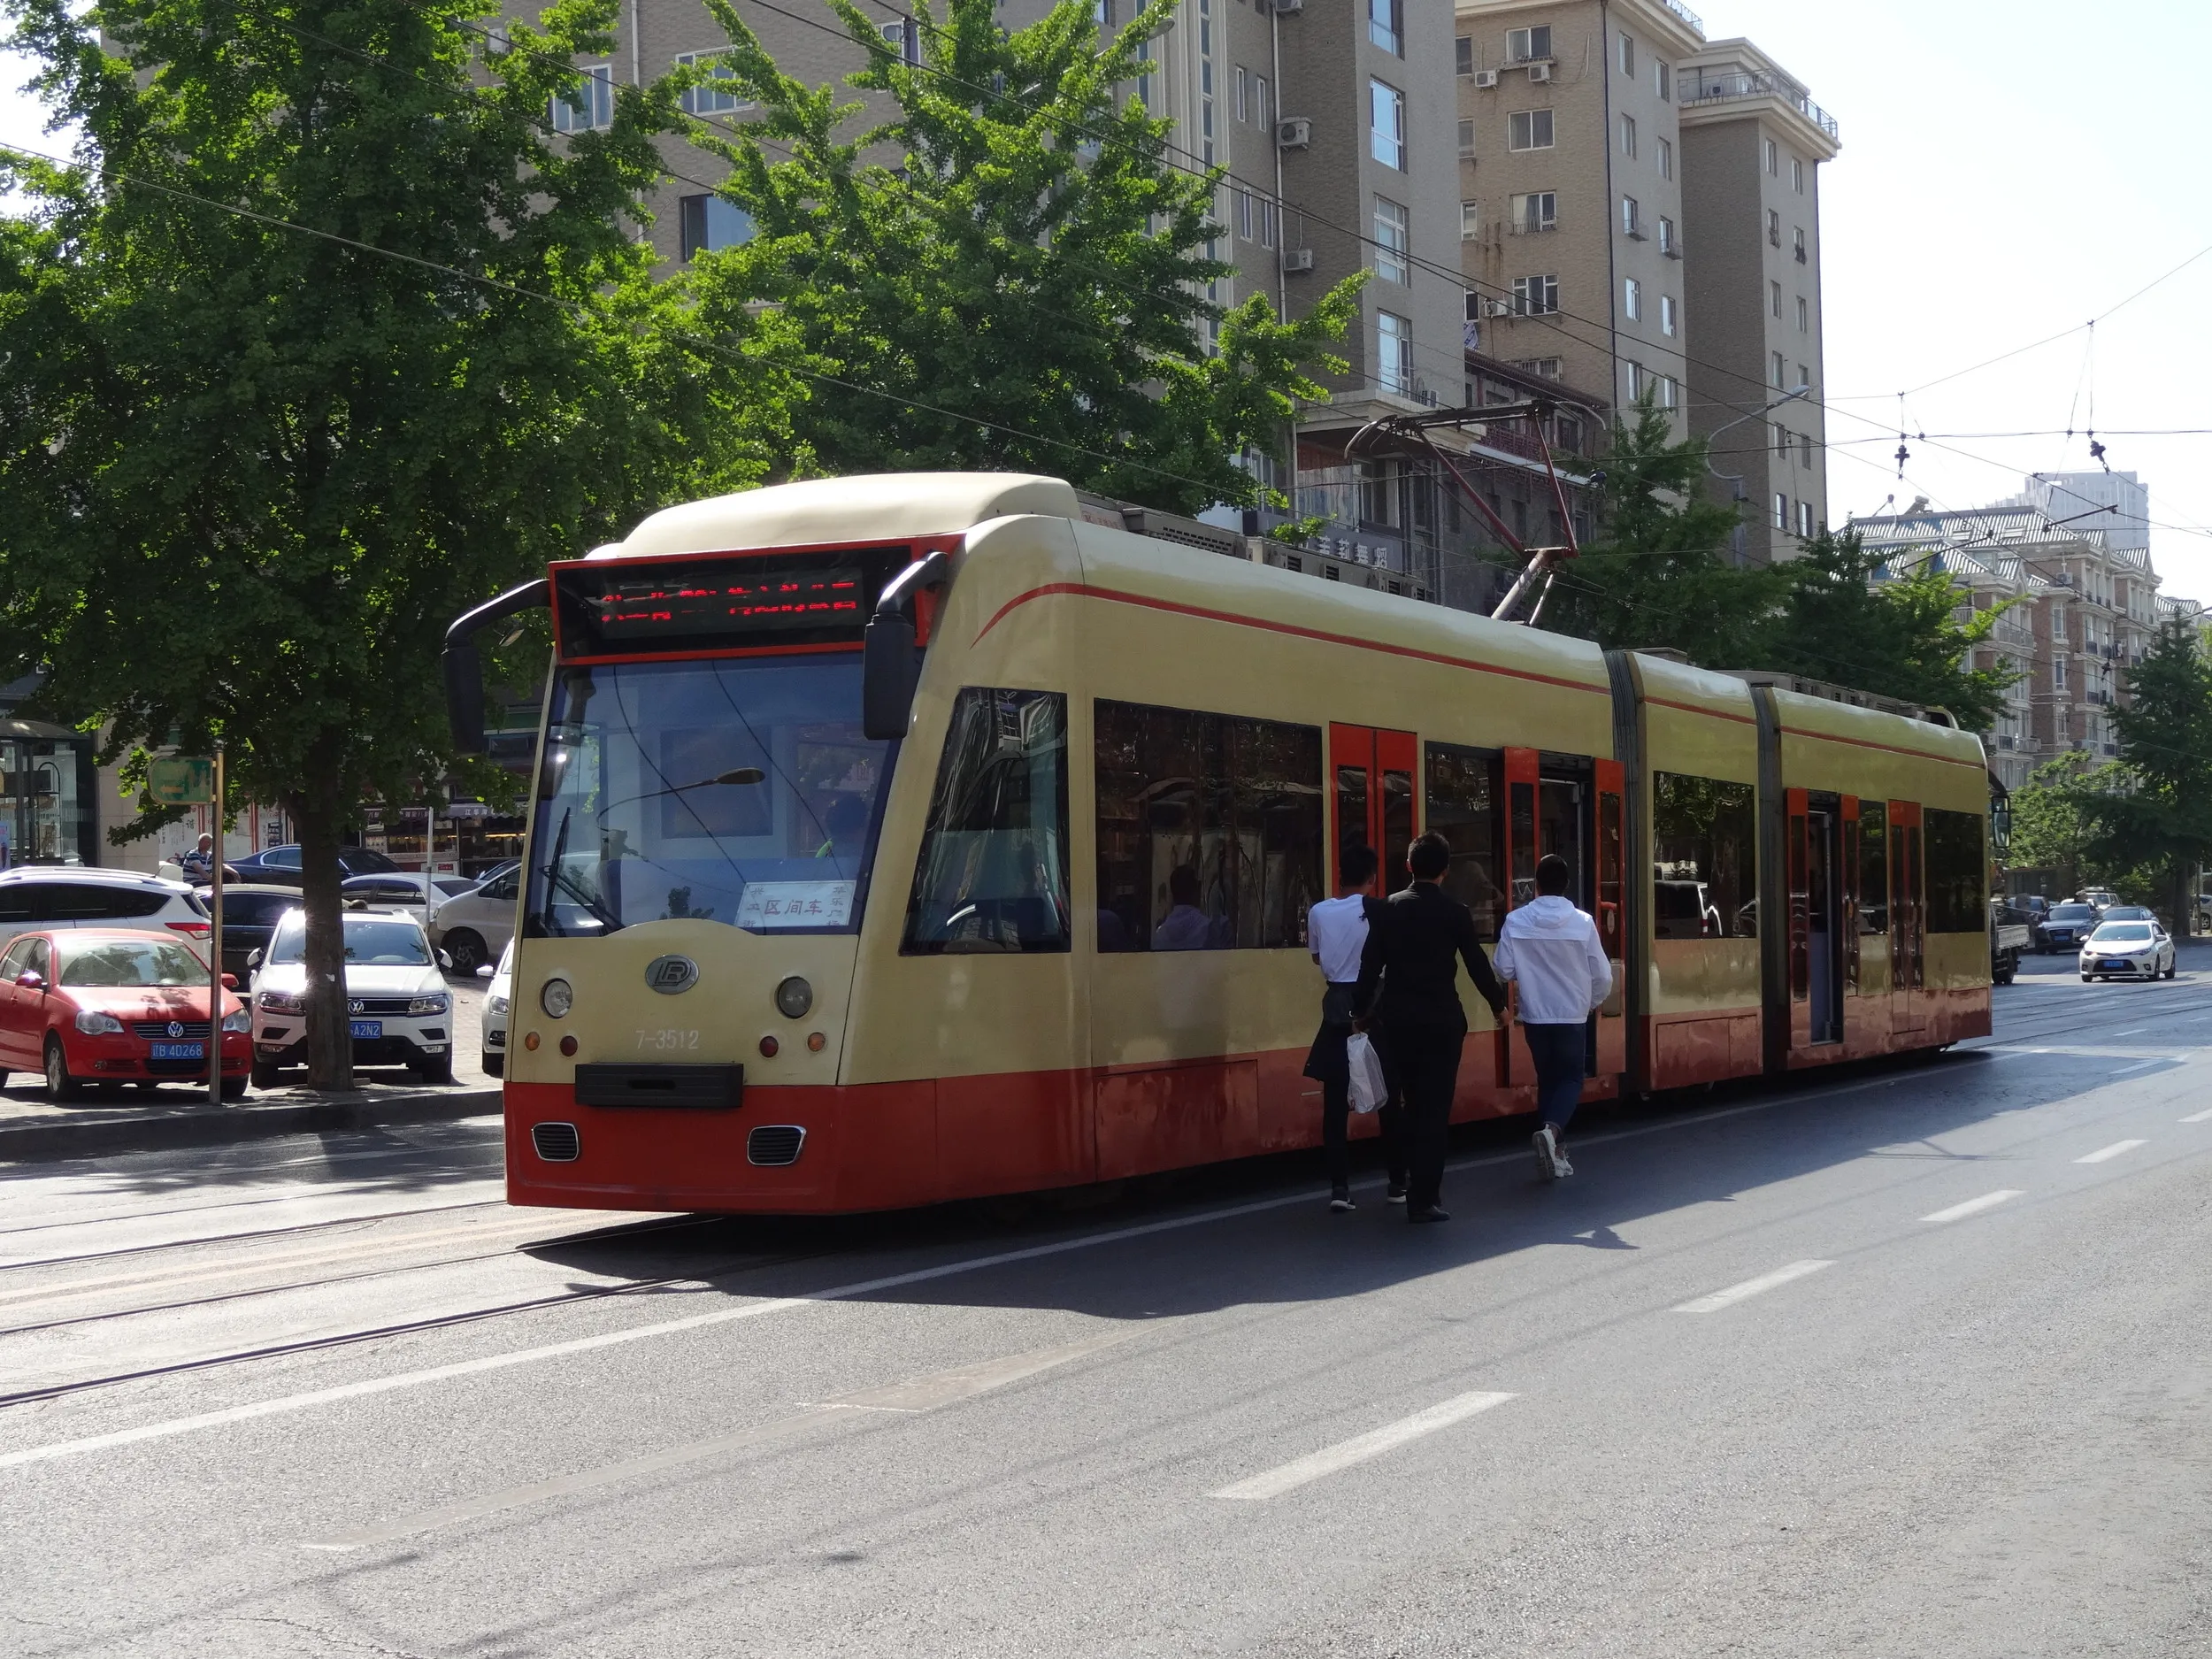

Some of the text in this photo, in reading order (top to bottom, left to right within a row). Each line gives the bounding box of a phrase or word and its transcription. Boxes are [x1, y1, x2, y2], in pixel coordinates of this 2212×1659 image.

[764, 898, 823, 916] 区间车
[635, 1030, 699, 1049] 7-3512
